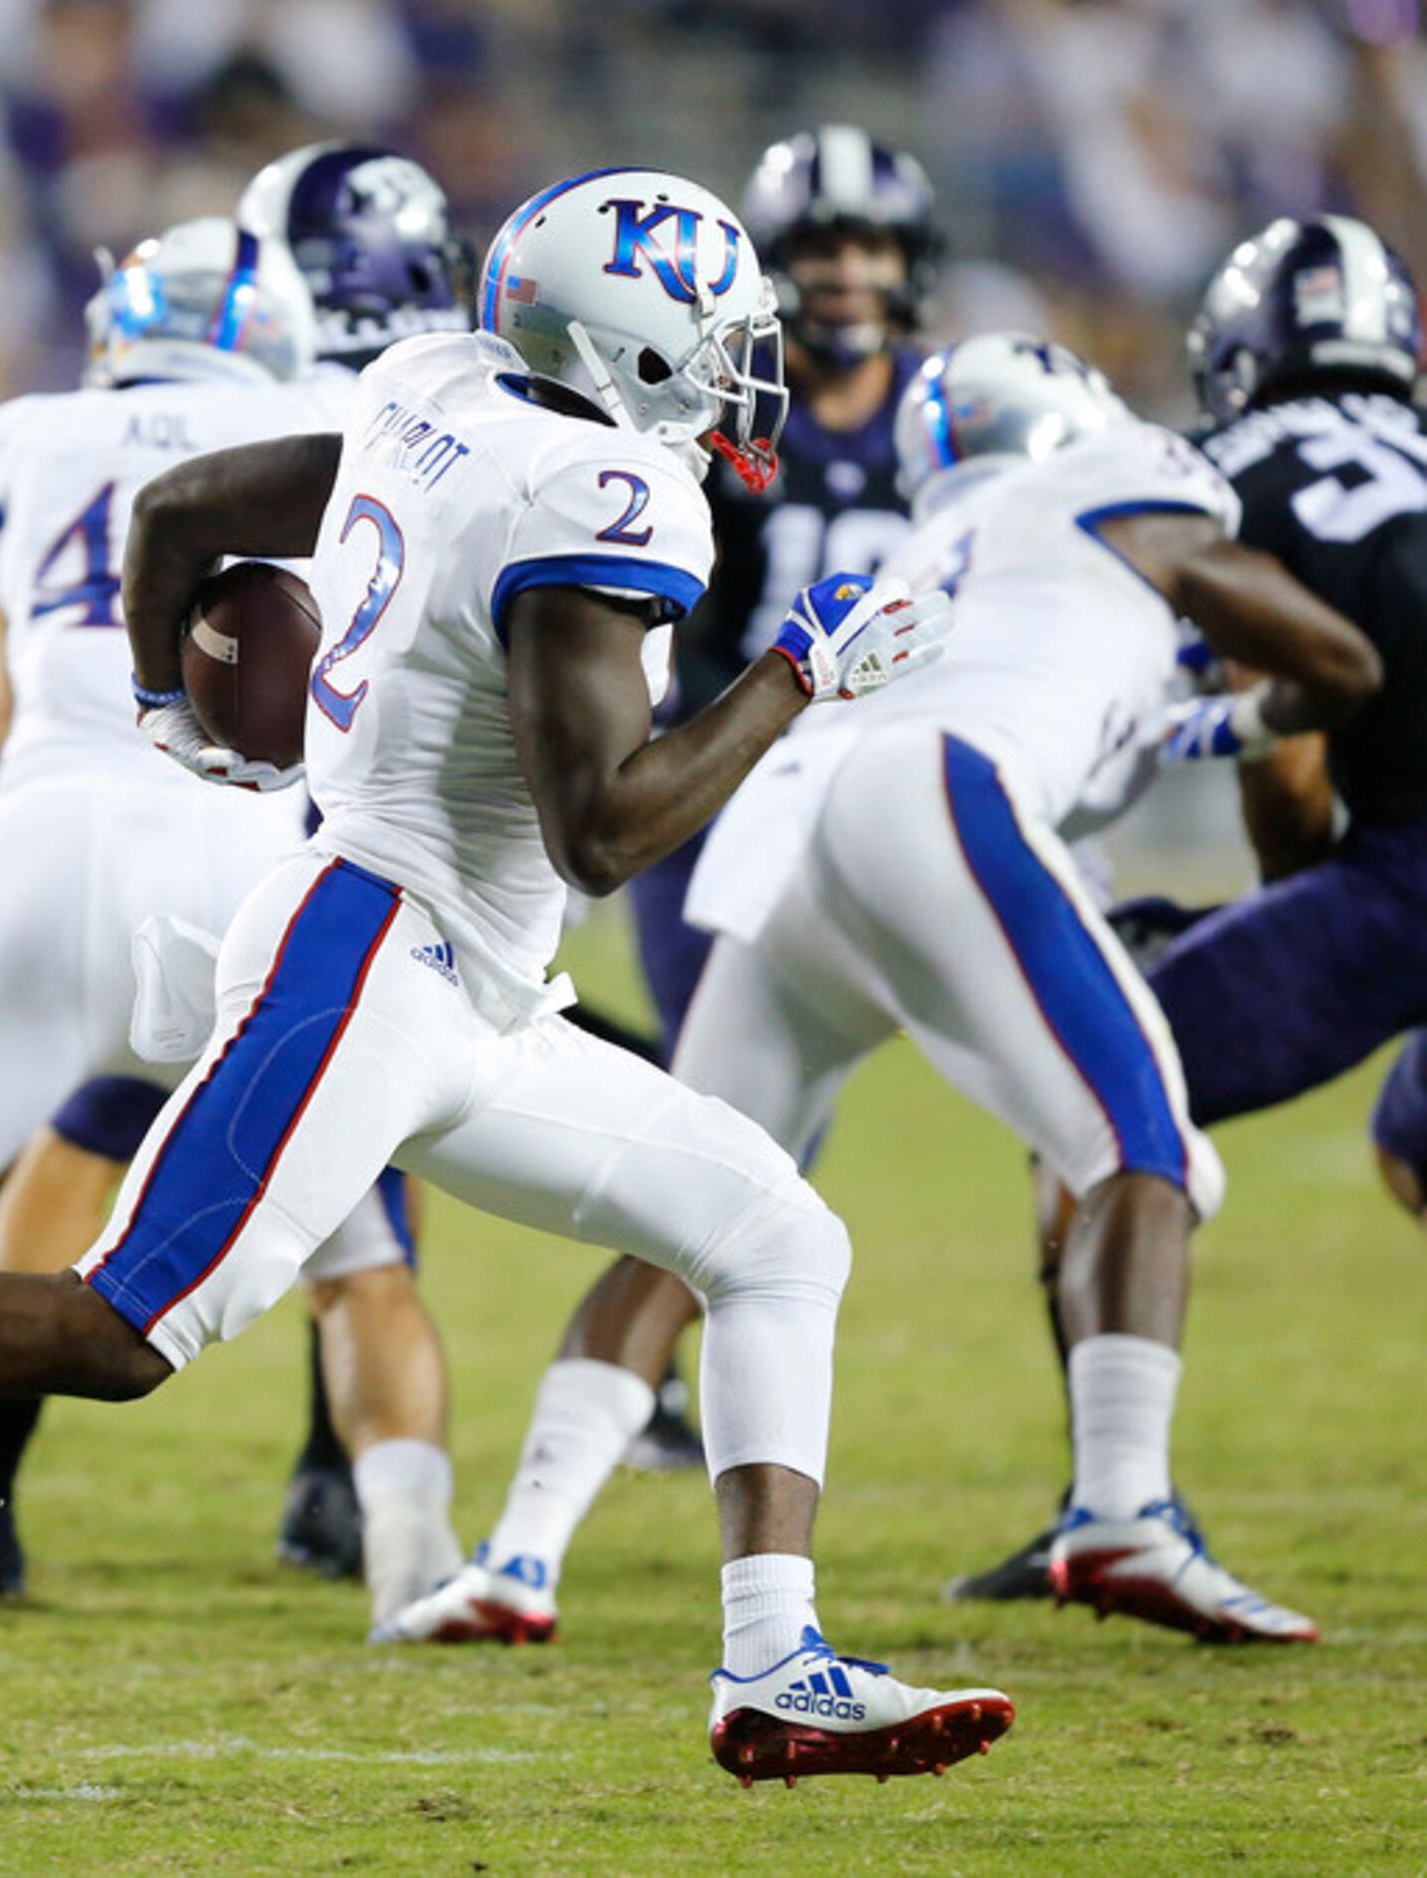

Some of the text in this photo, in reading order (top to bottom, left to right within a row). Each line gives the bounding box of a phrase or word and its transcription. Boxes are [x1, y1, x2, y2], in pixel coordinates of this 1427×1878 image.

[603, 198, 742, 305] KU
[595, 470, 654, 546] 2
[312, 493, 405, 733] 2
[774, 1690, 867, 1721] adidas
